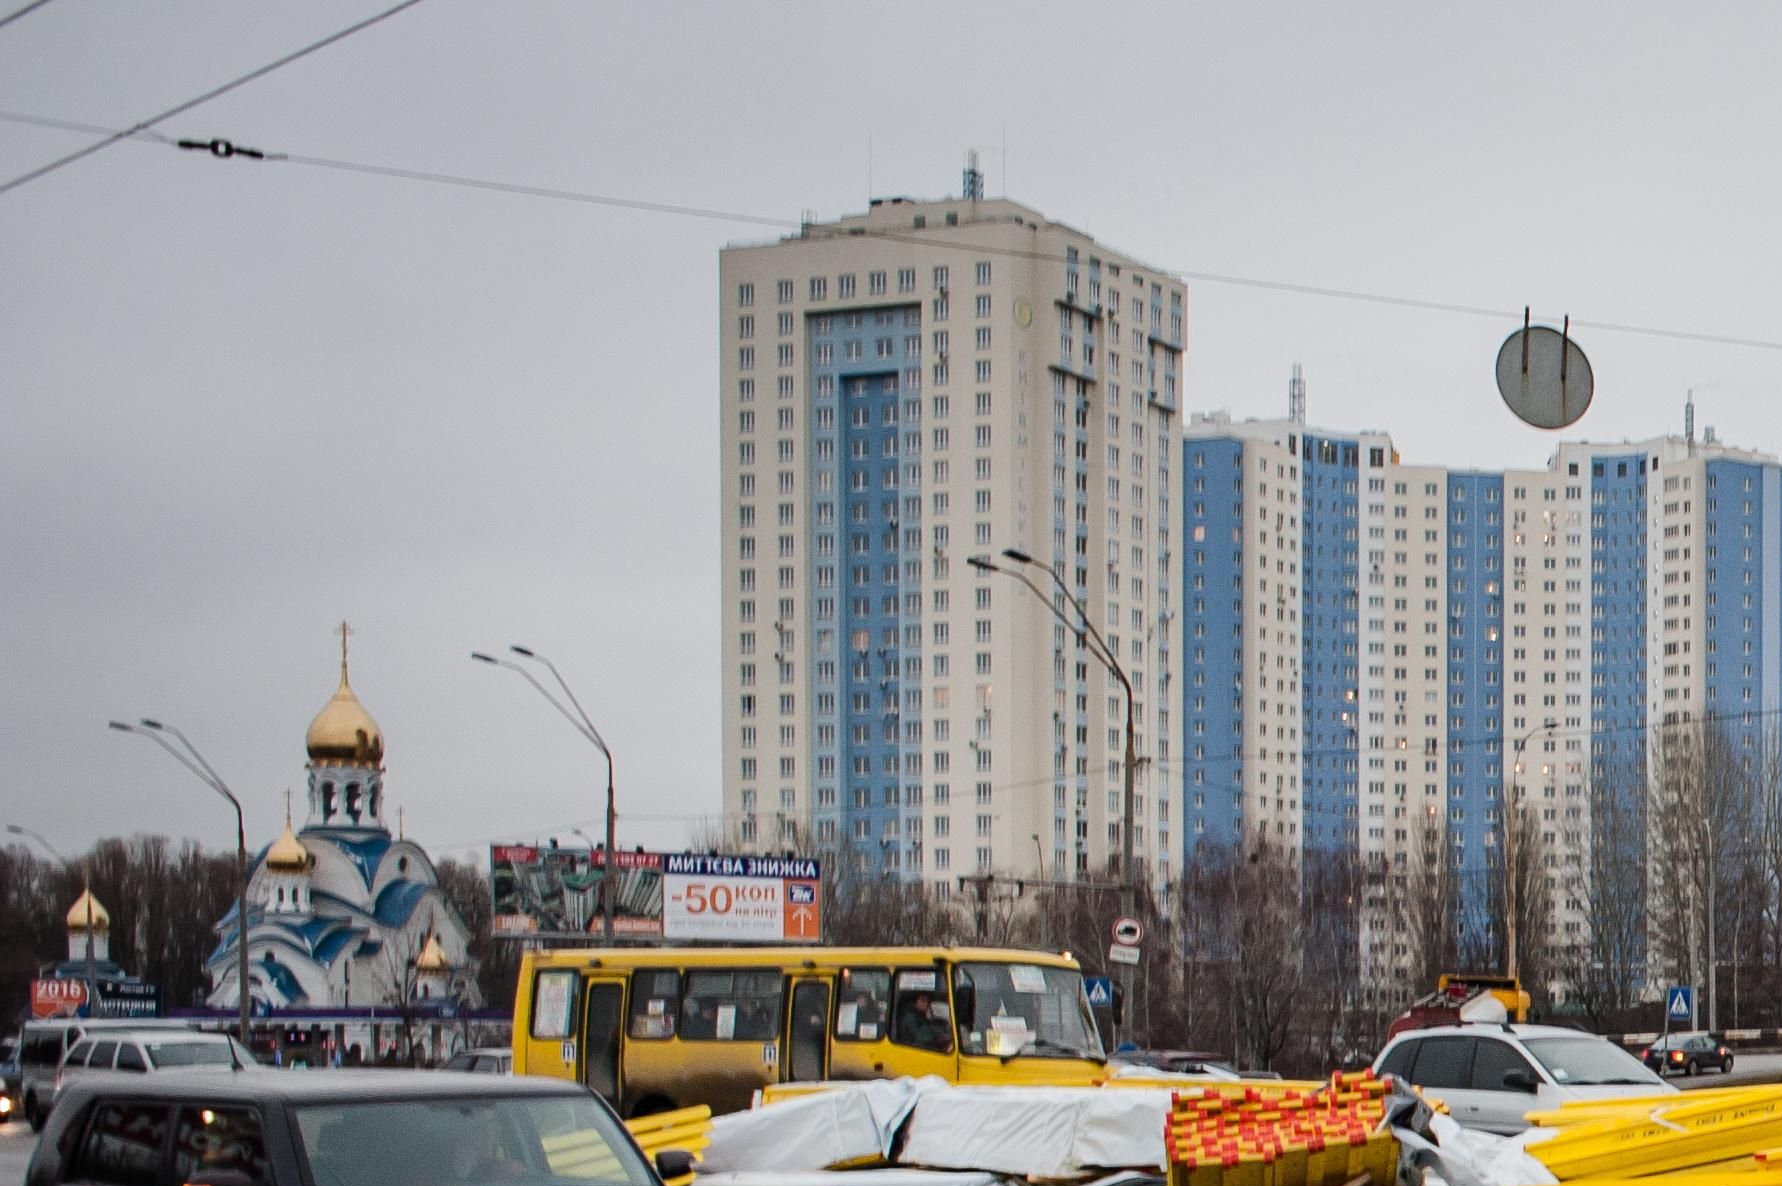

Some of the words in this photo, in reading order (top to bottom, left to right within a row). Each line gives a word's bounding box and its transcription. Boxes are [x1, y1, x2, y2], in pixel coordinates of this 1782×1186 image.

[668, 855, 744, 875] МИТТЄВА
[747, 858, 816, 878] ЗНИЖКА
[671, 883, 733, 915] -50
[37, 979, 81, 999] 2016
